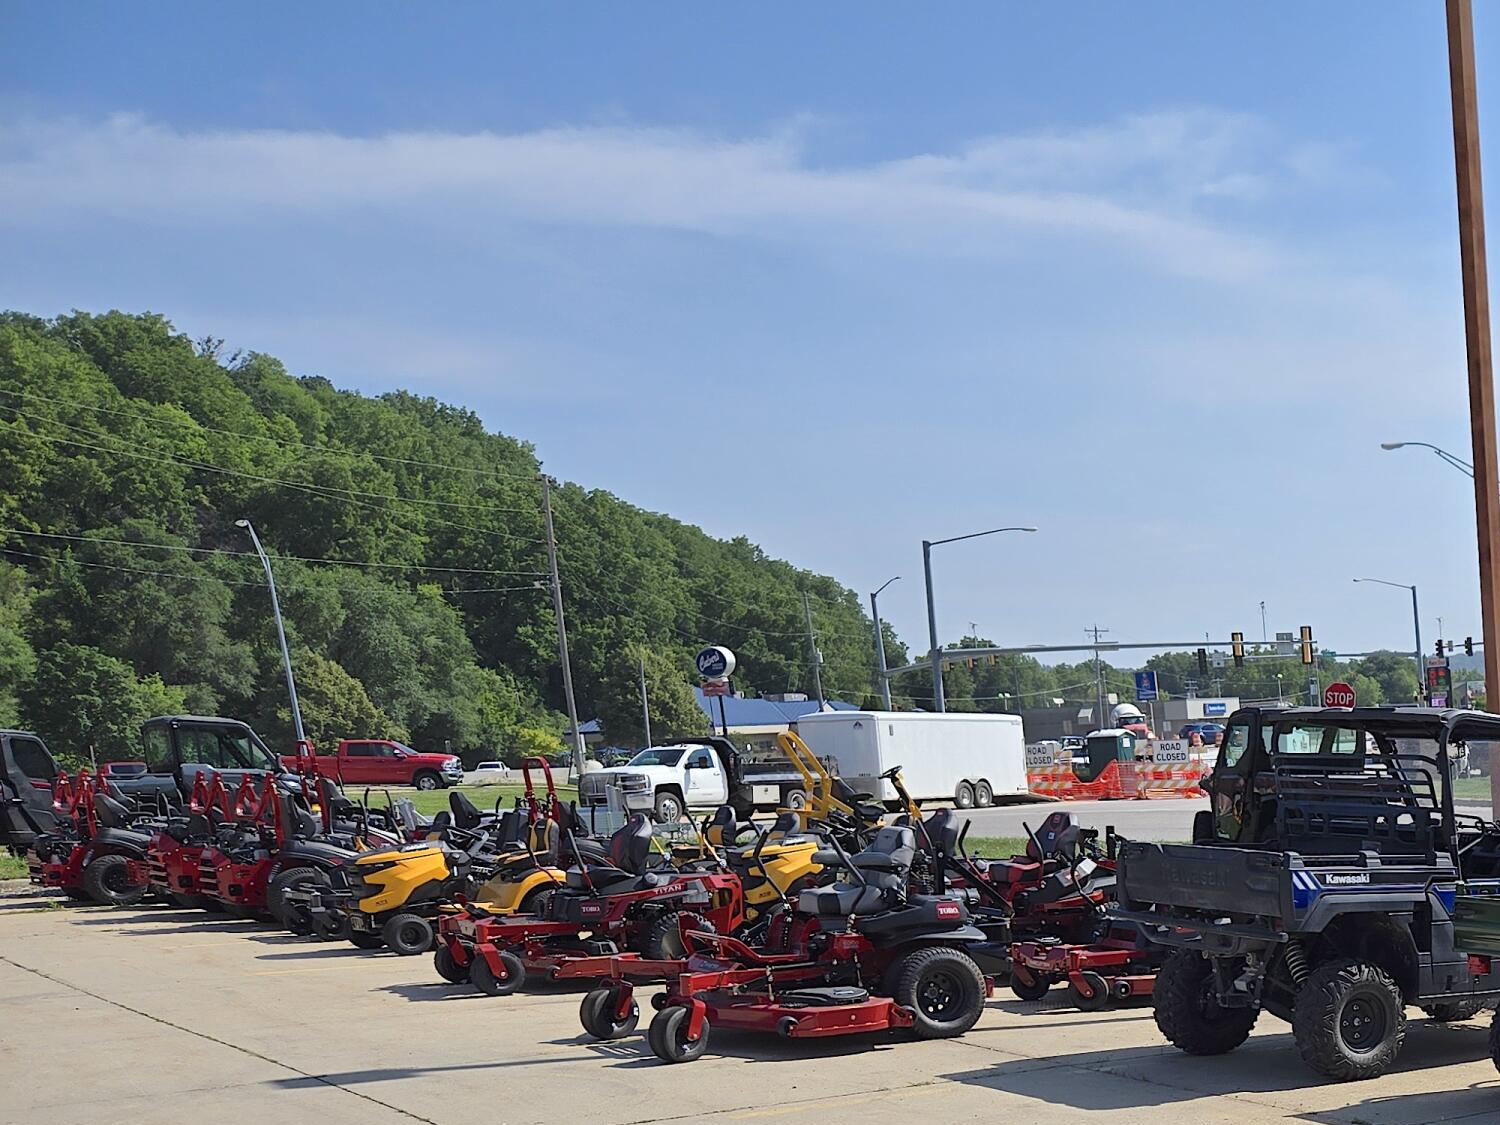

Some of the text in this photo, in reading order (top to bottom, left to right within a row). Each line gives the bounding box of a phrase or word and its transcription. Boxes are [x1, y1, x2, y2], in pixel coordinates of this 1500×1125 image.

[1326, 691, 1353, 704] STOP
[1027, 746, 1047, 755] ROAD
[1160, 742, 1181, 751] ROAD
[1156, 752, 1187, 762] CLOSED
[1326, 873, 1370, 885] Kawasaki
[655, 885, 682, 895] TITAN
[938, 907, 959, 915] TORO
